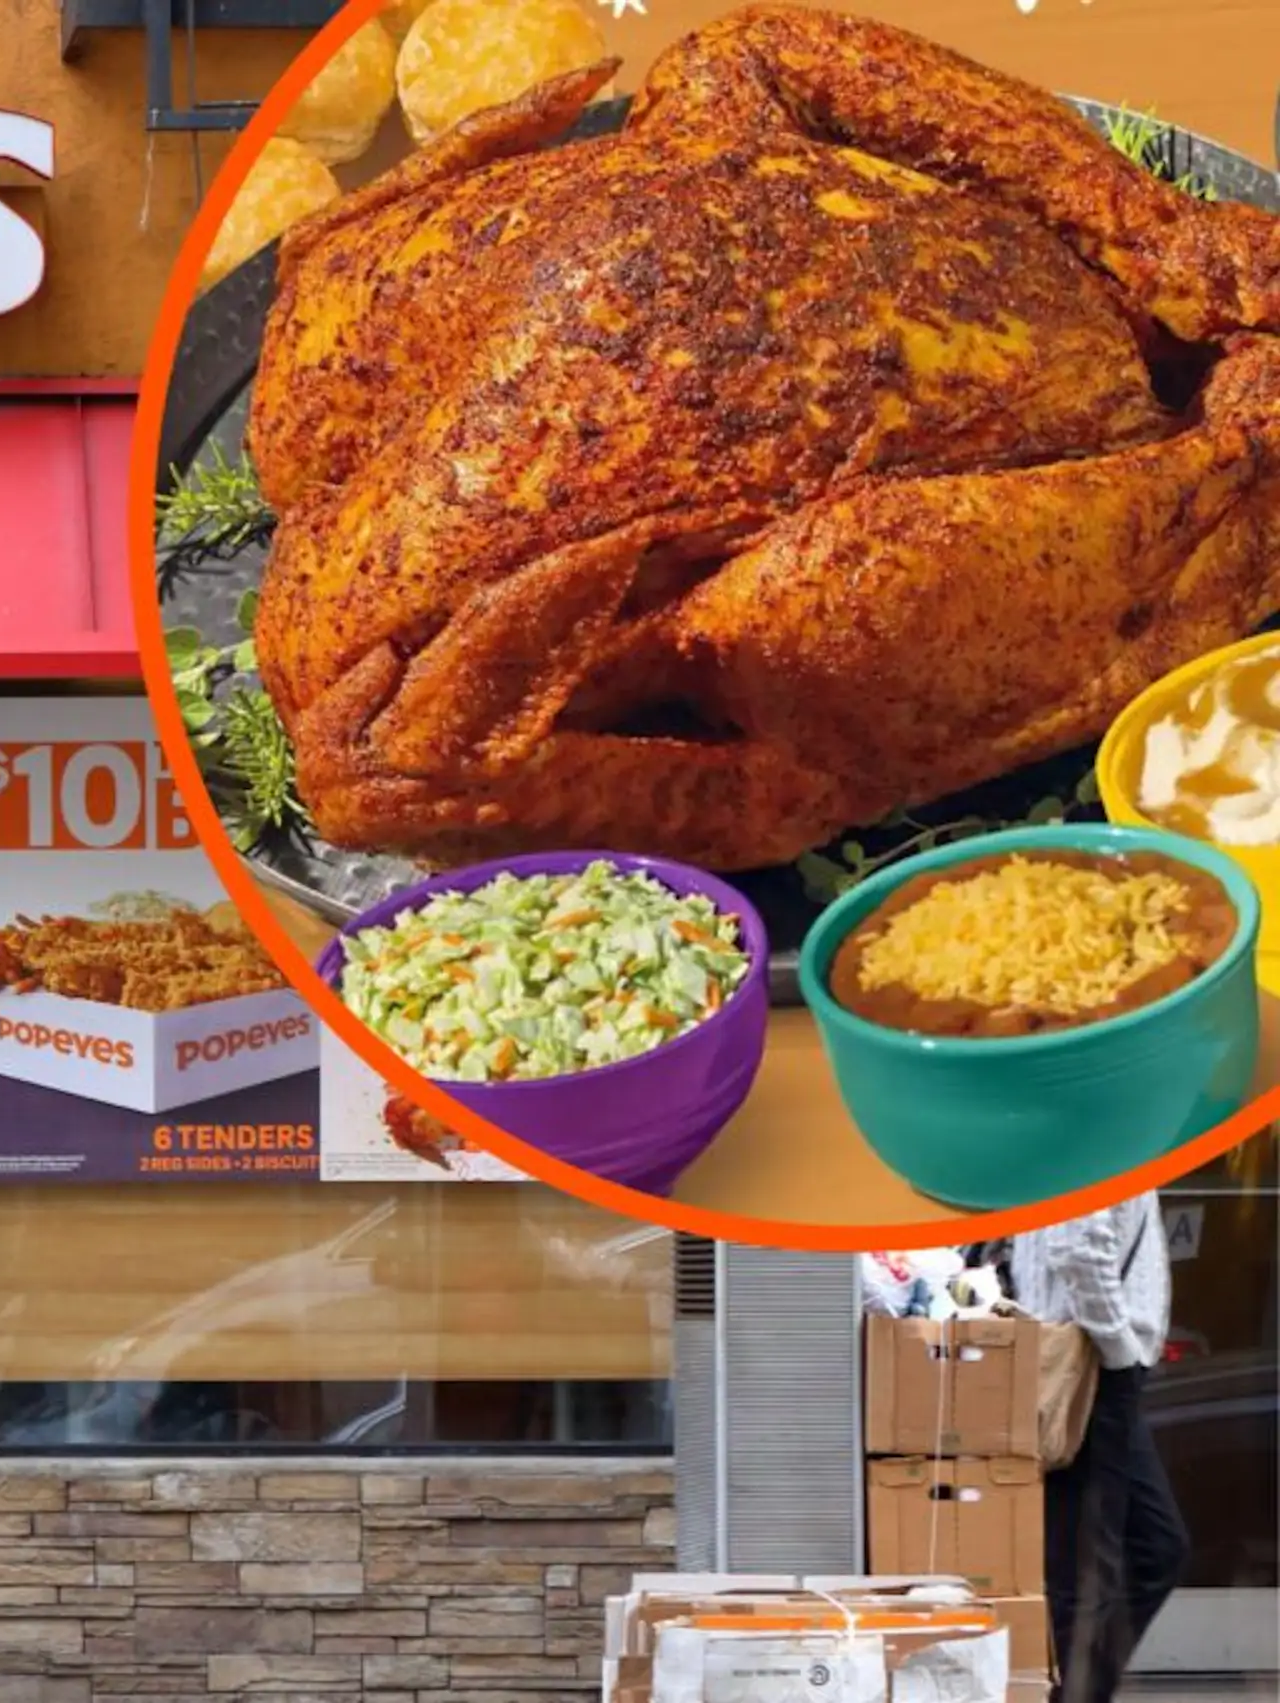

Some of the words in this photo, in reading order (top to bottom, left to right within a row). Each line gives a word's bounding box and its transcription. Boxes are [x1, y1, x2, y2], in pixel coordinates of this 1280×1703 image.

[154, 1125, 172, 1151] 6
[176, 1124, 314, 1150] TENDERS
[140, 1157, 150, 1172] 2
[150, 1156, 184, 1171] REG
[185, 1156, 232, 1171] SIDES
[1168, 1211, 1193, 1246] A
